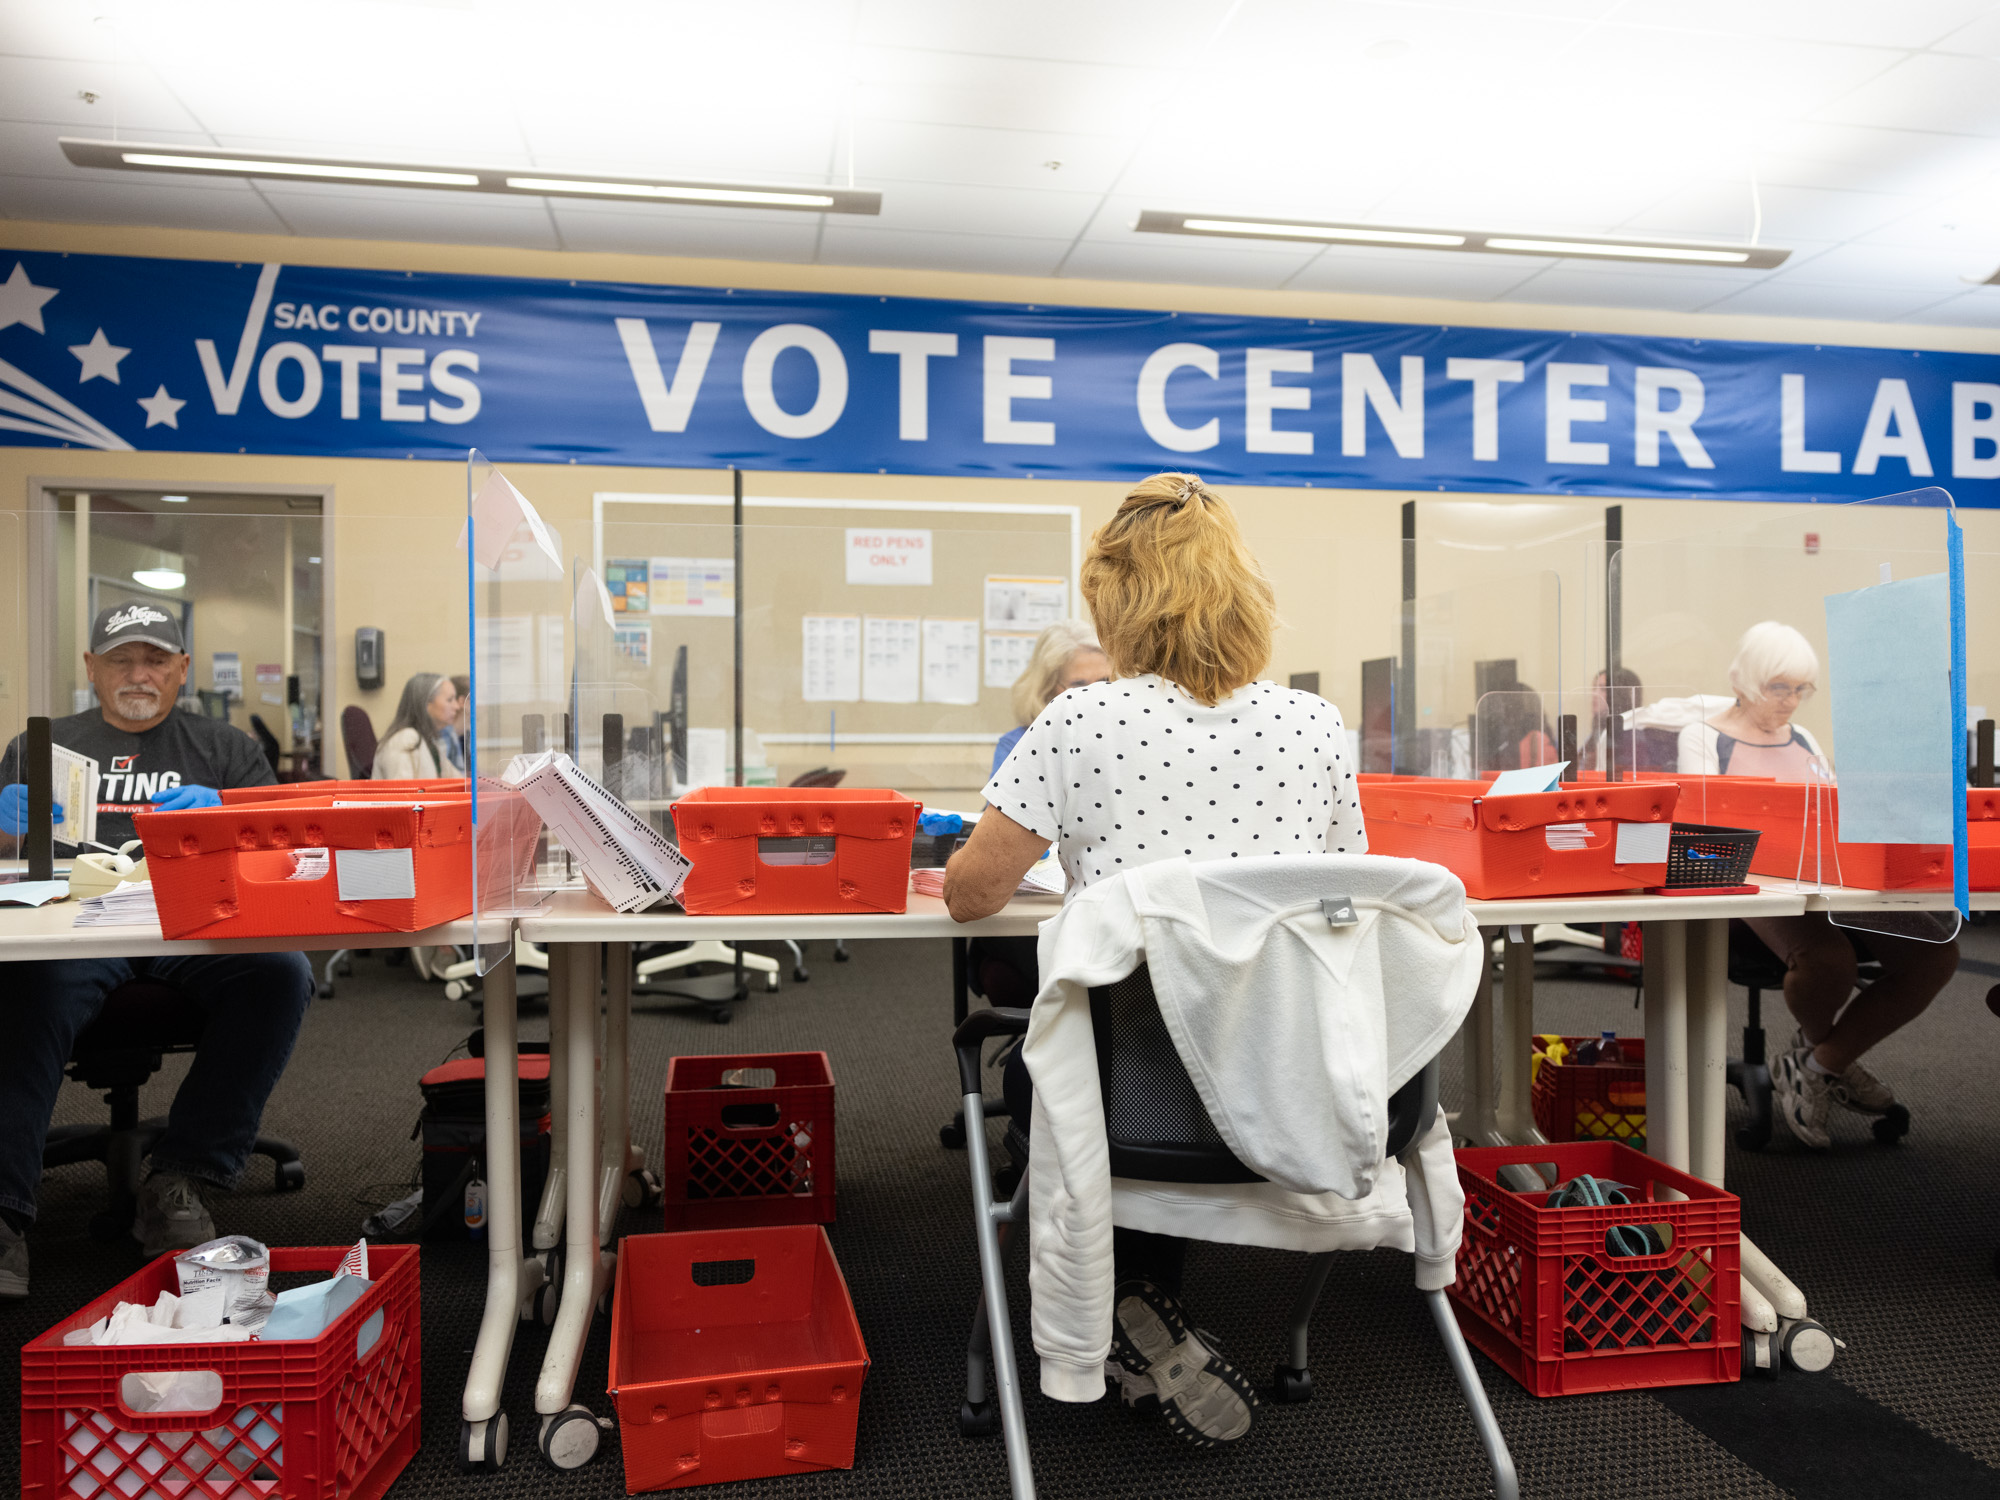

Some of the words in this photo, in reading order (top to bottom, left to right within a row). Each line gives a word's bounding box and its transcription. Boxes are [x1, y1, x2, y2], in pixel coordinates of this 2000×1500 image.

[274, 303, 339, 331] SAC
[347, 306, 482, 338] COUNTY
[195, 264, 482, 425] VOTES
[614, 318, 1057, 446] VOTE
[1135, 344, 1716, 469] CENTER
[853, 535, 883, 549] RED
[886, 535, 925, 549] PENS
[869, 554, 908, 567] ONLY
[105, 611, 130, 633] Las
[128, 605, 168, 626] Vegas
[98, 770, 182, 802] TING
